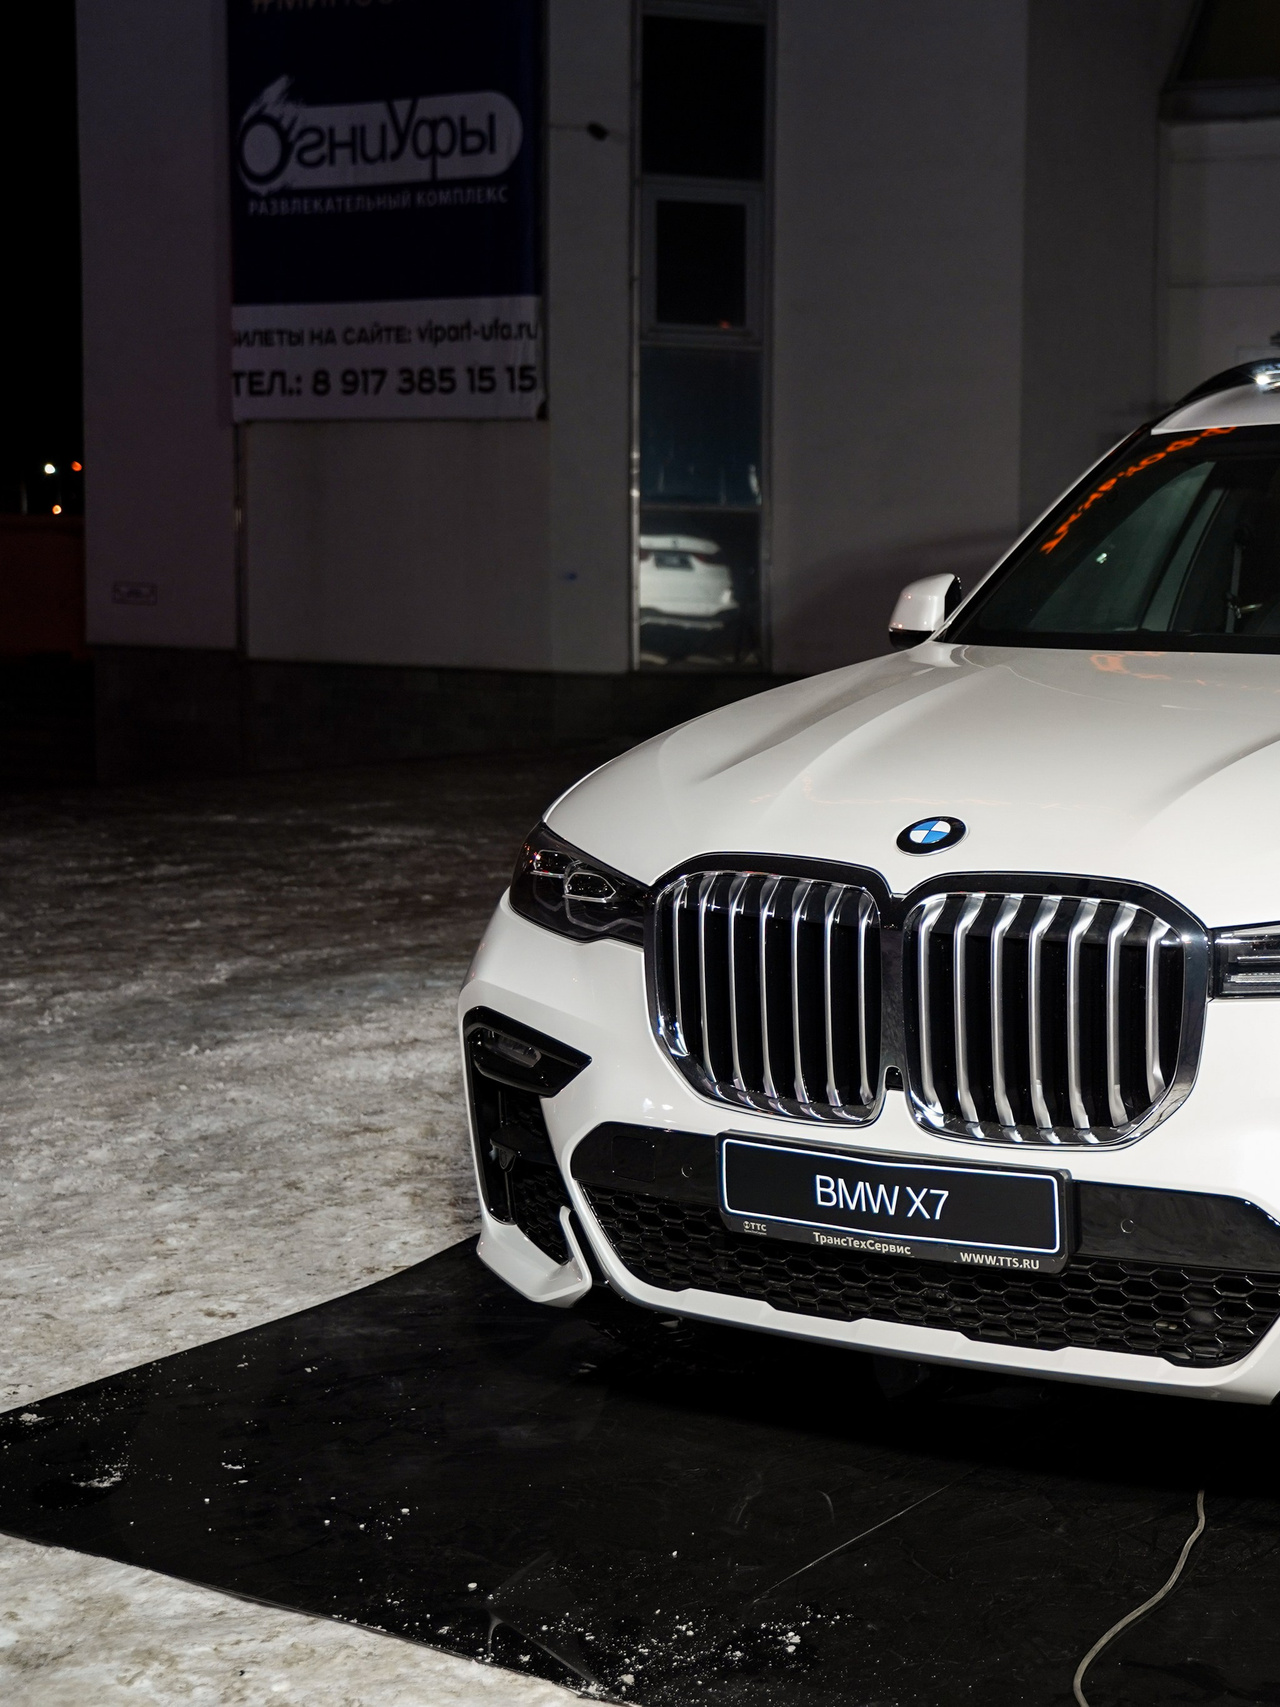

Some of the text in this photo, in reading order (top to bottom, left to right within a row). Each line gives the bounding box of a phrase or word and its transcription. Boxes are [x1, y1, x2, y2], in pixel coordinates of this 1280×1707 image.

[248, 185, 509, 217] РАЗВЛЕКАТЕЛЬНЫЙ КОМПЛЕКС
[233, 317, 538, 348] ИЛЕТЫ НА САЙТЕ: vipart-ufa.ru
[232, 364, 538, 397] ТЕЛ.: 8 917 385 15 15
[815, 1174, 949, 1220] BMW X7
[813, 1231, 911, 1254] ТрансТехСервис
[960, 1252, 1040, 1270] WWW.TTS.RU
